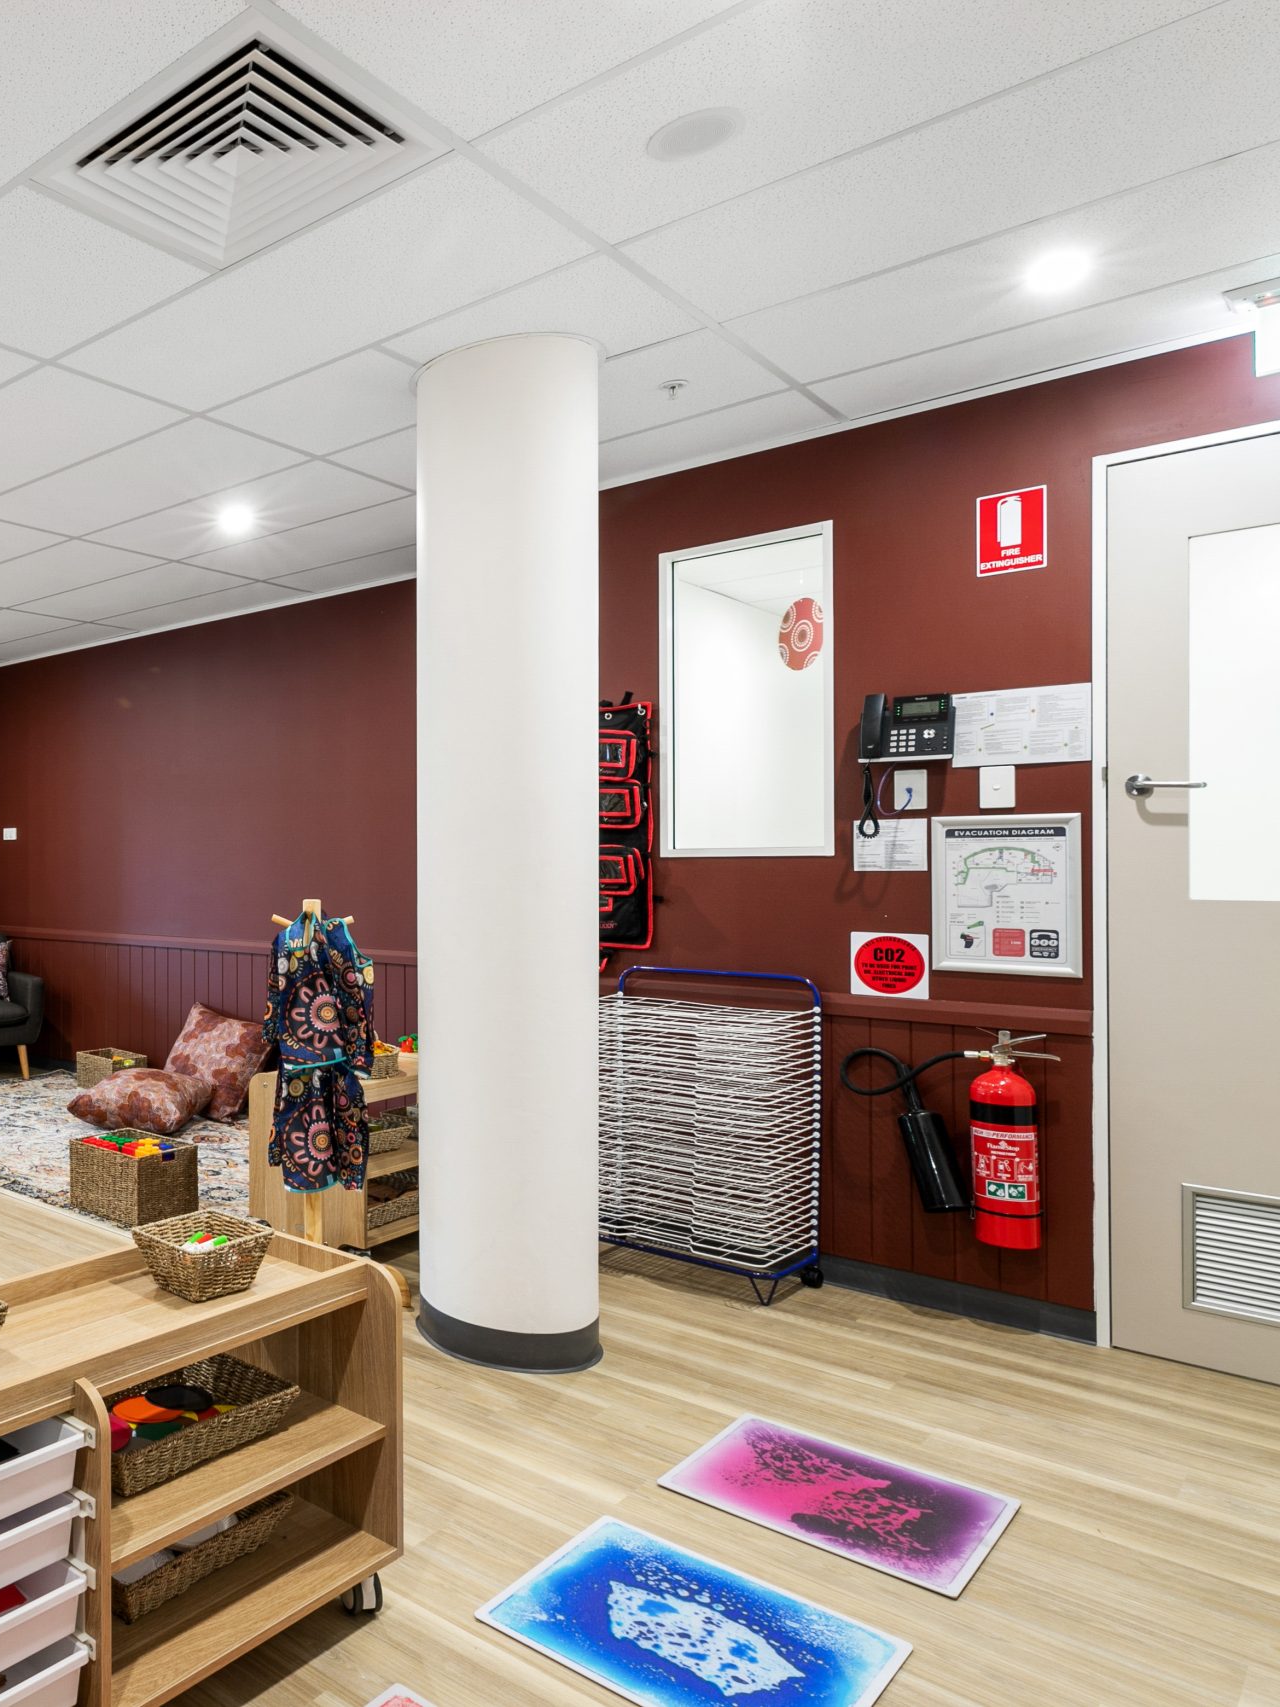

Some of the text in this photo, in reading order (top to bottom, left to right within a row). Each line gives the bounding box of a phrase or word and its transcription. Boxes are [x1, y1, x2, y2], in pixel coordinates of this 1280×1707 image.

[1001, 547, 1021, 557] FIRE
[980, 553, 1043, 571] EXTINGUISHER
[954, 828, 1055, 837] EVACUATION DIAGRAM
